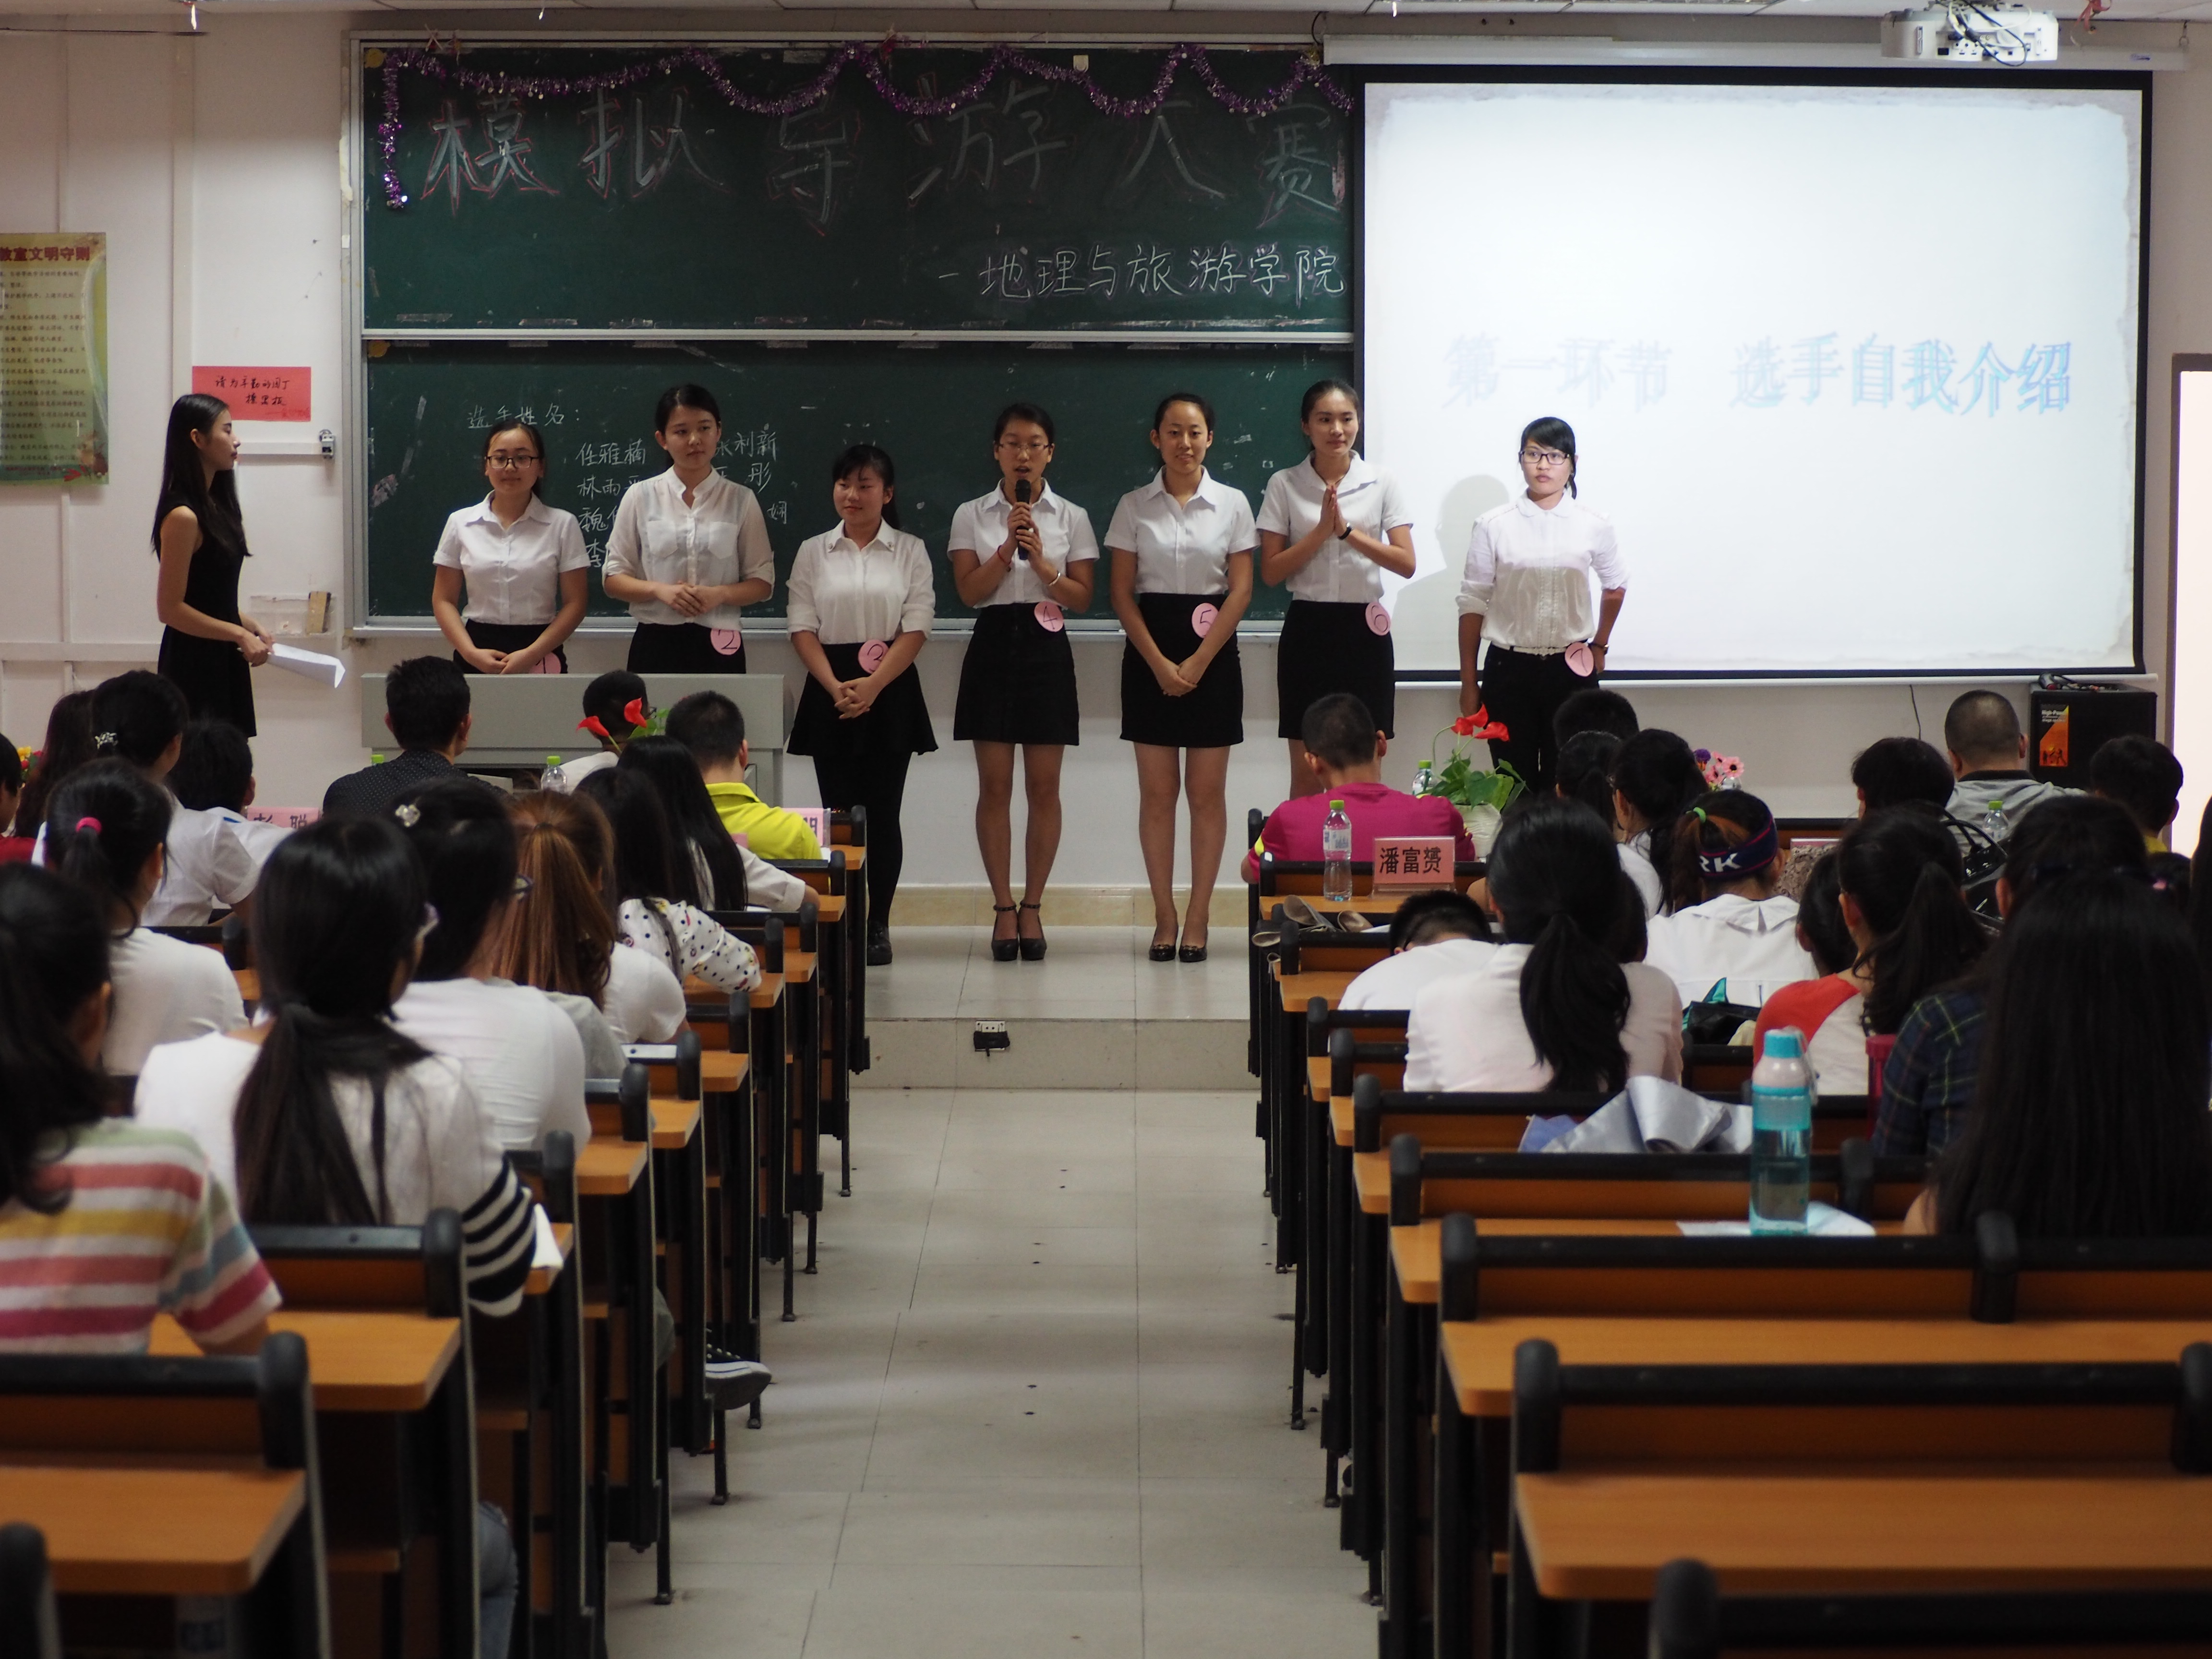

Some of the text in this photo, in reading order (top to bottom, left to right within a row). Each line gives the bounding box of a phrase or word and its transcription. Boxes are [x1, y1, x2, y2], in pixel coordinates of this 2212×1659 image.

[0, 246, 90, 261] 教室文明守则
[1442, 331, 2072, 418] 第一环节 选手自我介绍
[1043, 606, 1057, 630] 4
[1199, 609, 1213, 633] 5
[1371, 603, 1389, 632] 6
[718, 628, 738, 649] 2
[1379, 846, 1442, 874] 潘富赟
